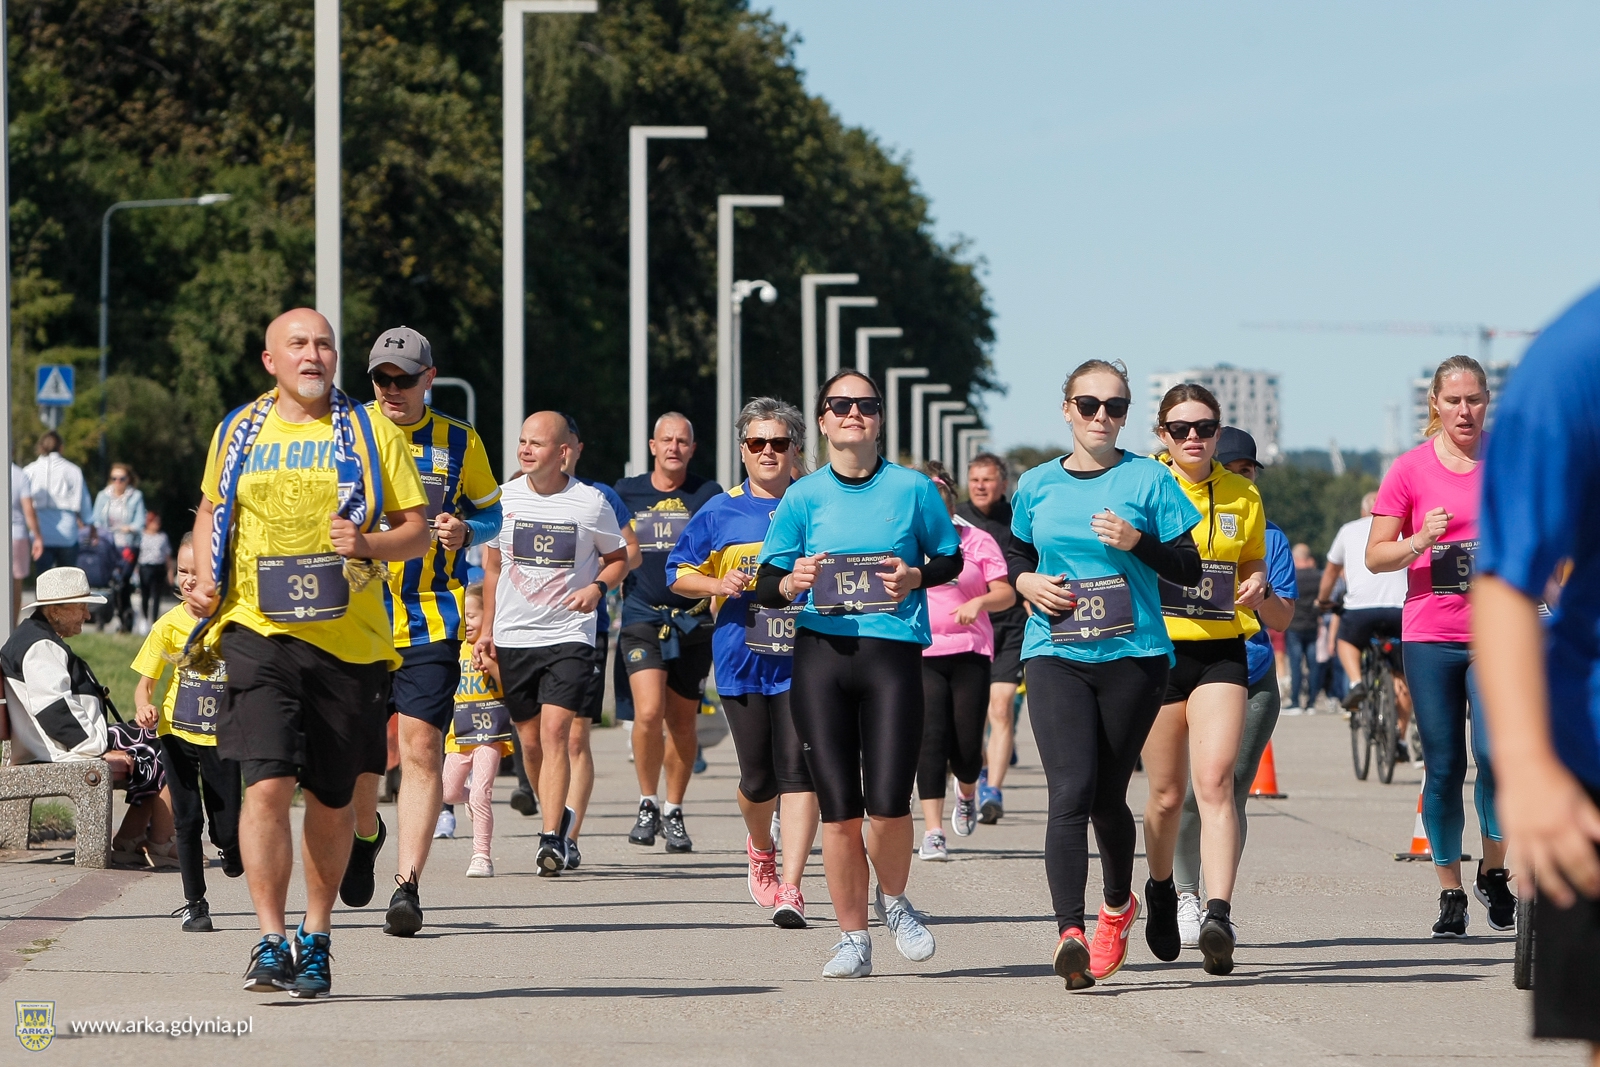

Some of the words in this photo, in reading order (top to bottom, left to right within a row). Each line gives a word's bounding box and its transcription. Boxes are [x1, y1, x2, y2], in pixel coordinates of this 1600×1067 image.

[653, 522, 672, 538] 114
[534, 534, 554, 553] 62
[287, 574, 319, 600] 39
[834, 570, 870, 595] 154
[1095, 578, 1124, 587] ARKOWCA
[766, 618, 796, 638] 109
[471, 712, 492, 730] 58
